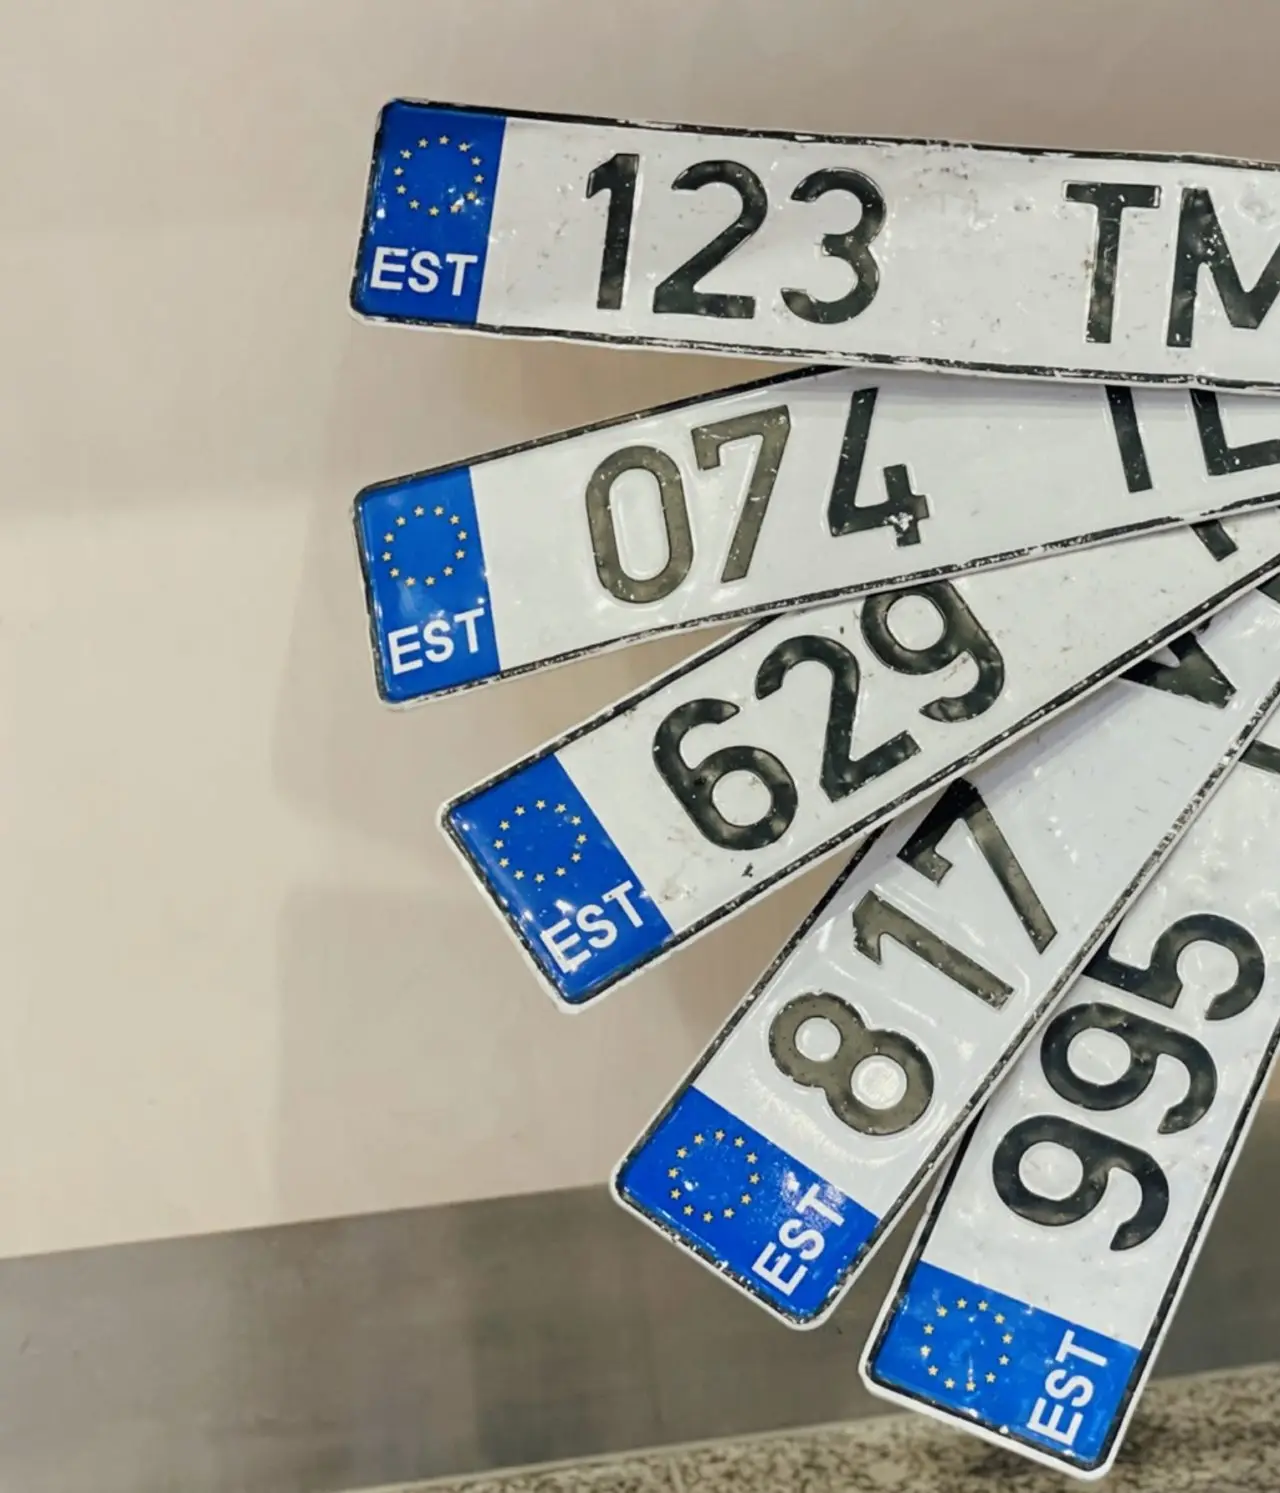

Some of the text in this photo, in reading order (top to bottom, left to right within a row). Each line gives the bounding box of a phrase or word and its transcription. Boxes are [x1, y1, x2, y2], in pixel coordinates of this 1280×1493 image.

[369, 246, 479, 298] EST
[586, 152, 888, 324] 123
[584, 387, 930, 604] 074
[387, 607, 486, 675] EST
[651, 579, 1005, 852] 629
[539, 880, 648, 975] EST
[768, 777, 1058, 1137] 817
[991, 913, 1266, 1253] 995
[752, 1185, 847, 1298] EST
[1026, 1329, 1109, 1447] EST
